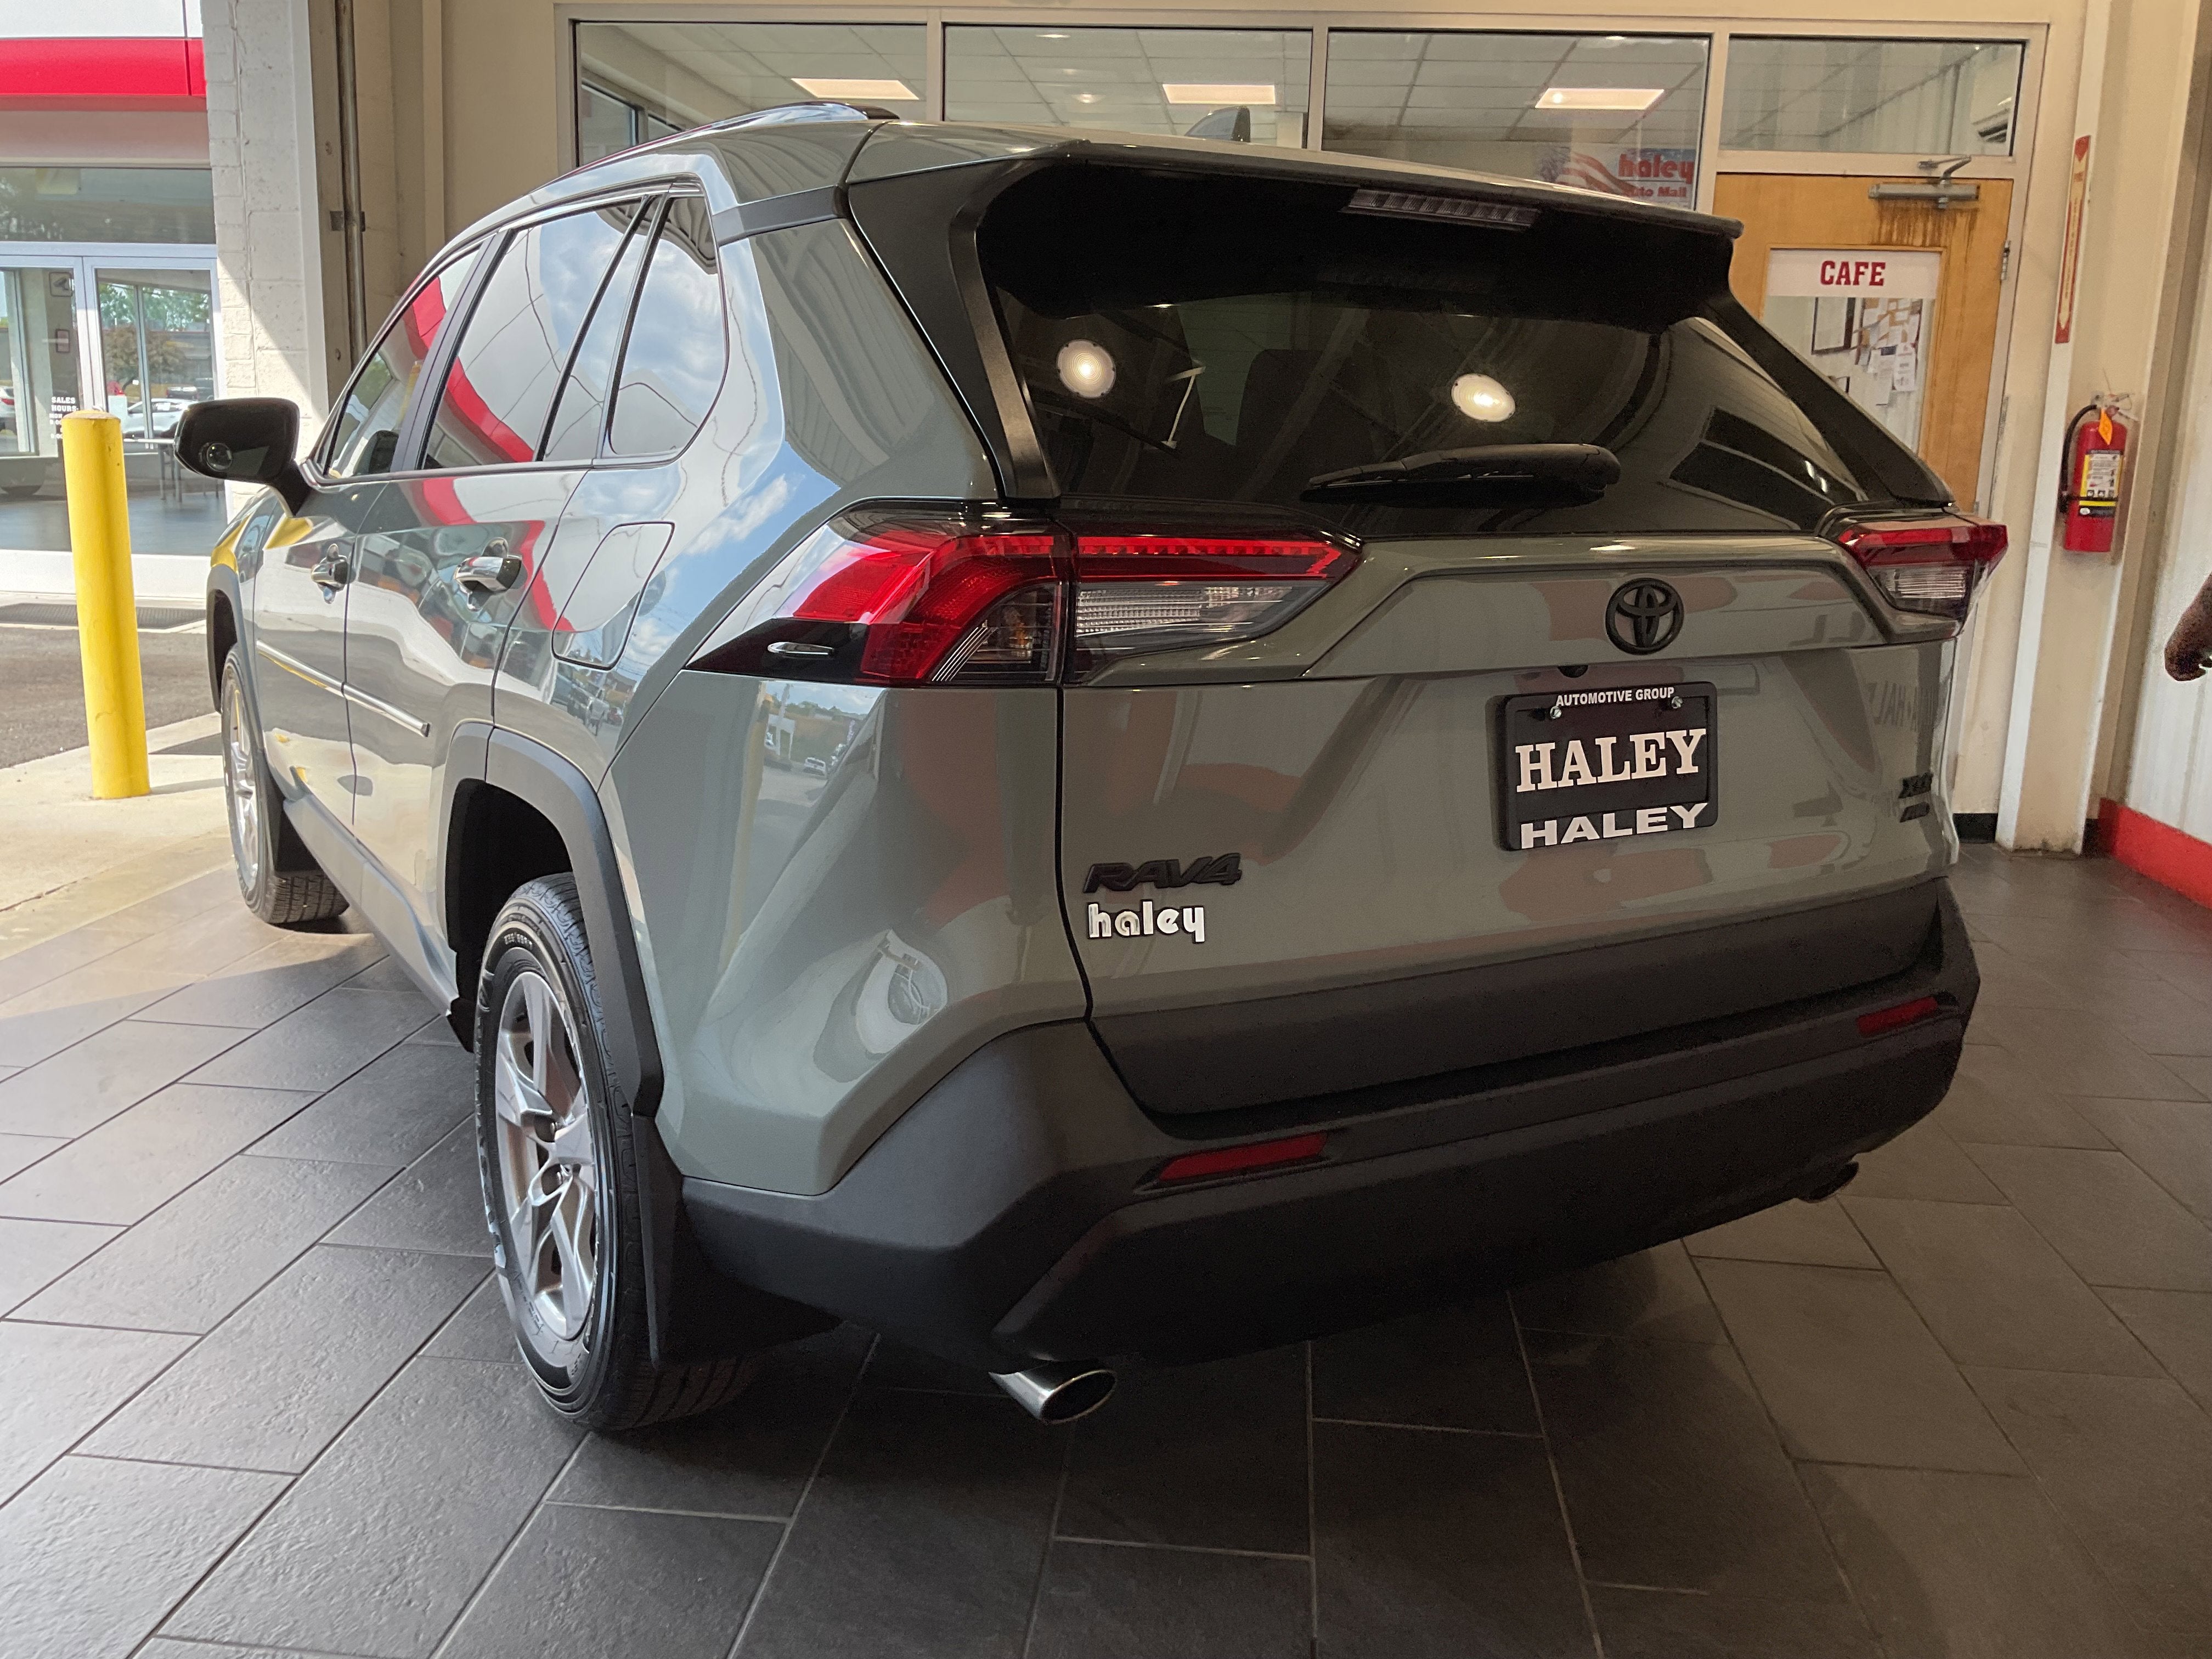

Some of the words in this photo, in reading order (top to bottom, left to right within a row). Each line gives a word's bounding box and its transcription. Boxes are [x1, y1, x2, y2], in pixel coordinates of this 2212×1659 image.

[1619, 154, 1694, 184] haley
[1657, 187, 1687, 197] Mall
[1820, 261, 1886, 286] CAFE
[1556, 690, 1632, 707] AUTOMOTIVE
[1635, 686, 1674, 700] GROUP
[1515, 728, 1706, 793] HALEY
[1521, 802, 1708, 849] HALEY
[1083, 853, 1242, 893] RAV4
[1087, 900, 1206, 943] haley
